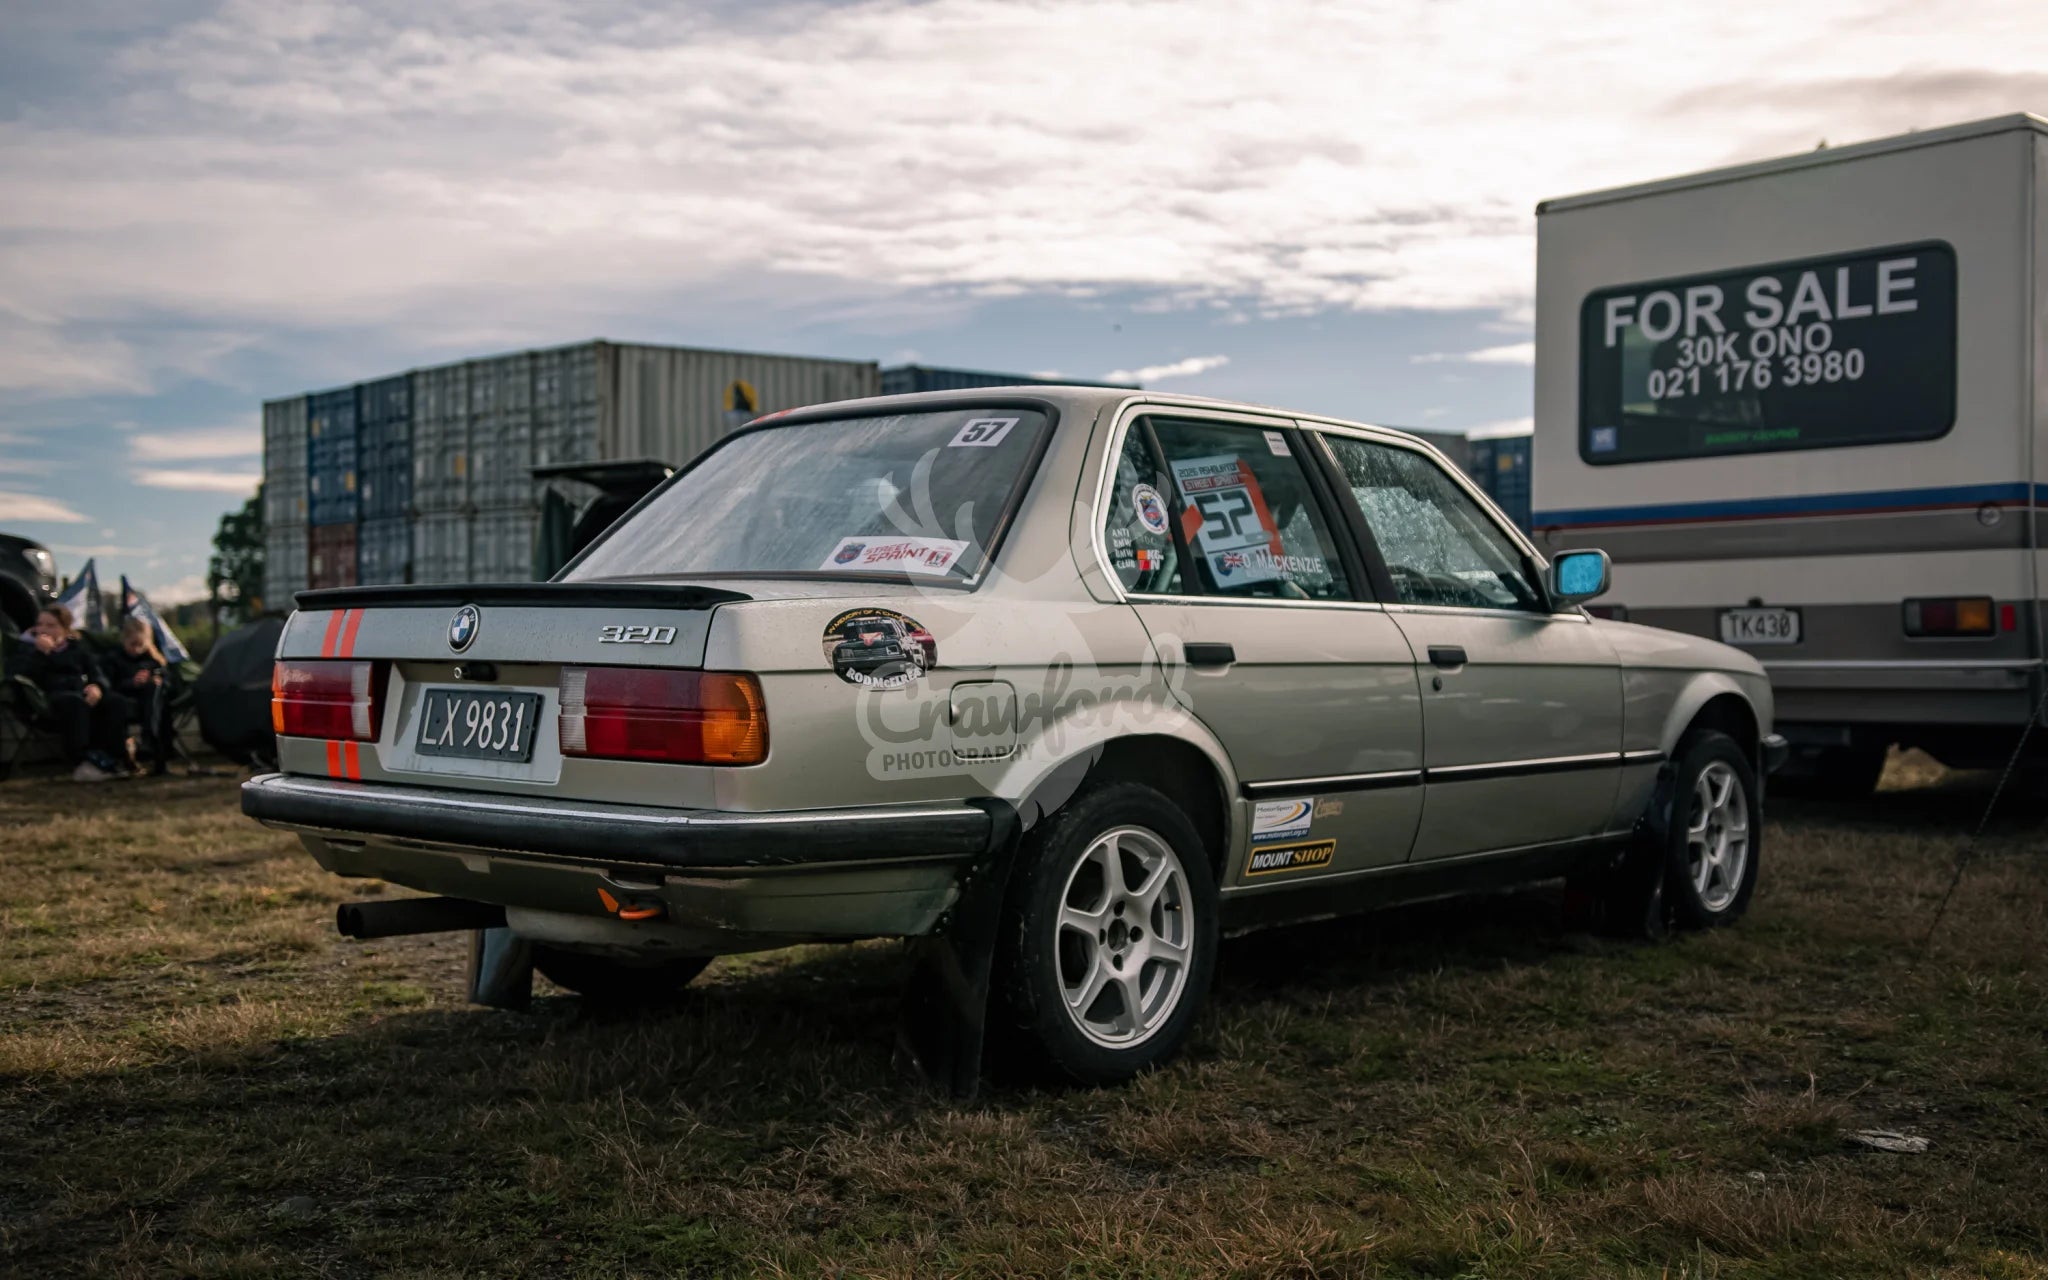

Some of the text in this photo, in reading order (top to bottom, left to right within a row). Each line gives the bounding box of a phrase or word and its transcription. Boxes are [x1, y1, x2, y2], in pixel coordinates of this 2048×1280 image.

[1604, 258, 1918, 347] FOR SALE
[1677, 322, 1832, 368] 30K ONO
[1648, 349, 1865, 399] 021 176 3980
[961, 421, 1009, 443] 57
[1112, 528, 1130, 538] ANTI
[863, 547, 931, 564] SPRINT
[1256, 553, 1323, 573] MACKENZIE
[835, 610, 861, 628] MEMORY
[1728, 613, 1791, 639] TK430
[598, 625, 677, 643] 320
[845, 667, 872, 685] ROD
[1251, 847, 1332, 869] MOUNT SHOP
